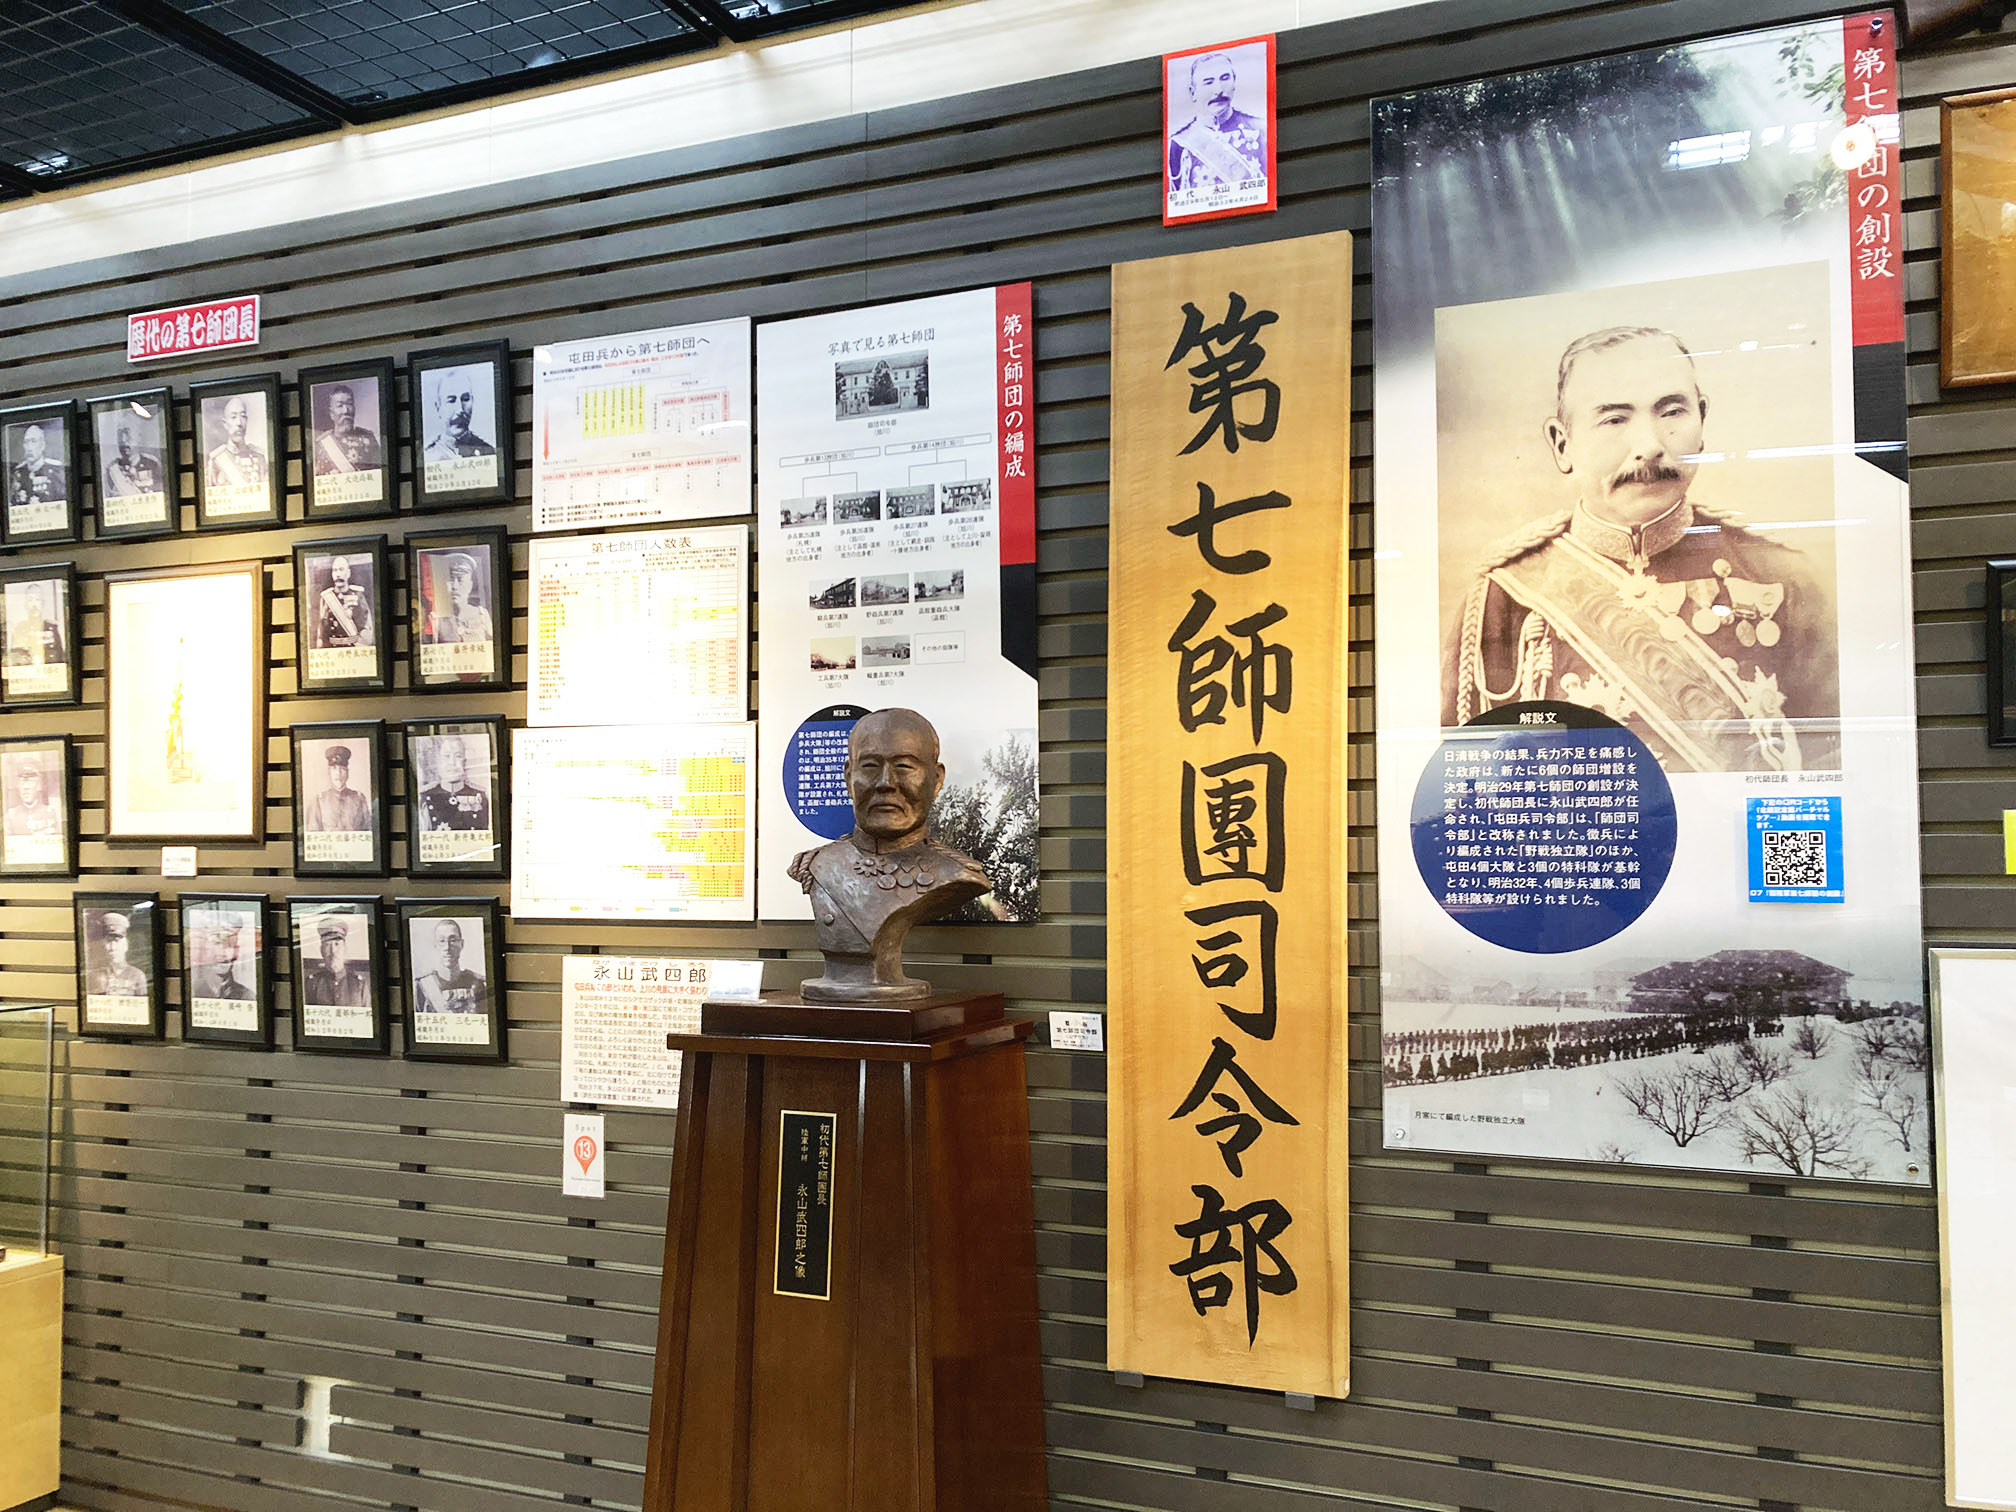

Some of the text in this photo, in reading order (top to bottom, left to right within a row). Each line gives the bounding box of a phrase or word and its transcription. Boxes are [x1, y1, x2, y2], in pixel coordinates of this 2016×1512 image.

[1852, 47, 1895, 280] 第七団の創設
[131, 303, 254, 356] 歴代の第七師団長
[827, 327, 936, 355] 写真で見る第七師団
[568, 335, 711, 365] 屯田兵から第七師団へ
[1003, 313, 1026, 478] 第七師団の編成
[591, 536, 692, 554] 第七師団人数表
[832, 709, 851, 717] 解説文
[1519, 711, 1557, 725] 解説文
[1444, 746, 1637, 762] 日清戦争の結果、兵力不足を痛感し
[1444, 763, 1637, 778] た政府は、新たに6個の師団増設を
[1444, 779, 1639, 794] 決定。明治29年第七師団の創設が決
[1444, 796, 1639, 810] 定し、初代師団長に永山武四郎が任
[1163, 291, 1301, 1353] 第七師團司令部
[1444, 811, 1639, 825] 命され、「屯田兵司令部」は、「師団司
[1444, 828, 1639, 841] 令部」と改称されました。徴兵によ
[1445, 844, 1639, 857] り編成された「野戦独立隊」のほか、
[1445, 861, 1640, 874] 屯田4個大隊と3個の特科隊が基幹
[1445, 876, 1641, 890] となり、明治32年、4個歩兵連隊、3個
[1445, 892, 1600, 907] 特科隊等が設けられました。
[593, 965, 707, 983] 永山武四郎
[1415, 1110, 1526, 1126] 月寒にて編成した野戦独立大隊
[578, 1141, 592, 1158] 13
